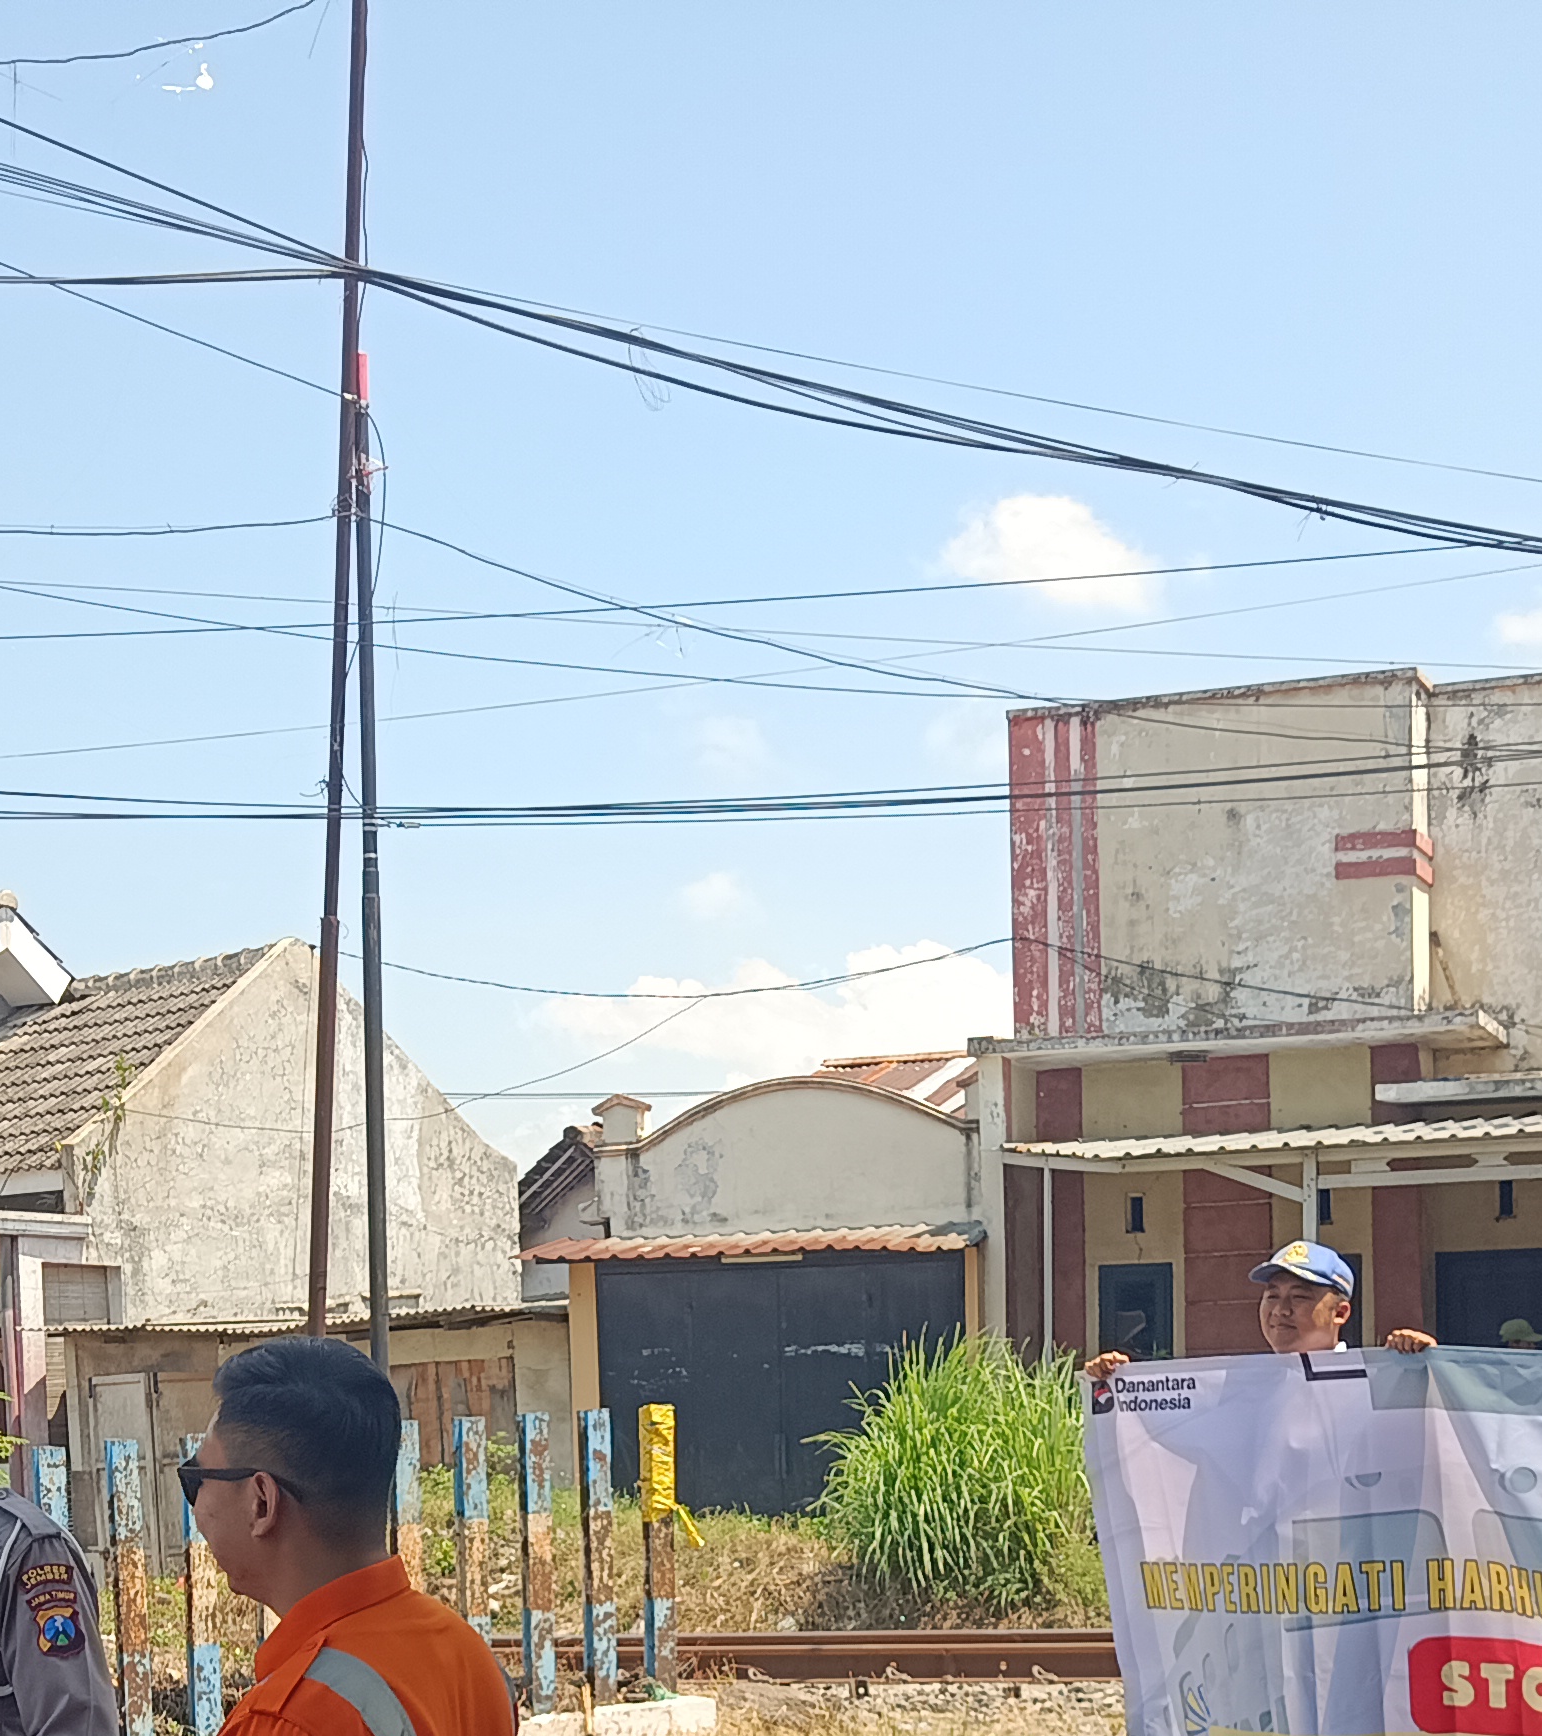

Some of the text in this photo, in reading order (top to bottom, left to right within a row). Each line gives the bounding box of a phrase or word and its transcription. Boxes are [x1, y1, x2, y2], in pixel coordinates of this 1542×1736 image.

[1115, 1375, 1196, 1394] Danantara
[1116, 1392, 1192, 1412] Indonesia
[1140, 1559, 1406, 1614] MEMPERINGATI
[30, 1593, 51, 1607] JAWA
